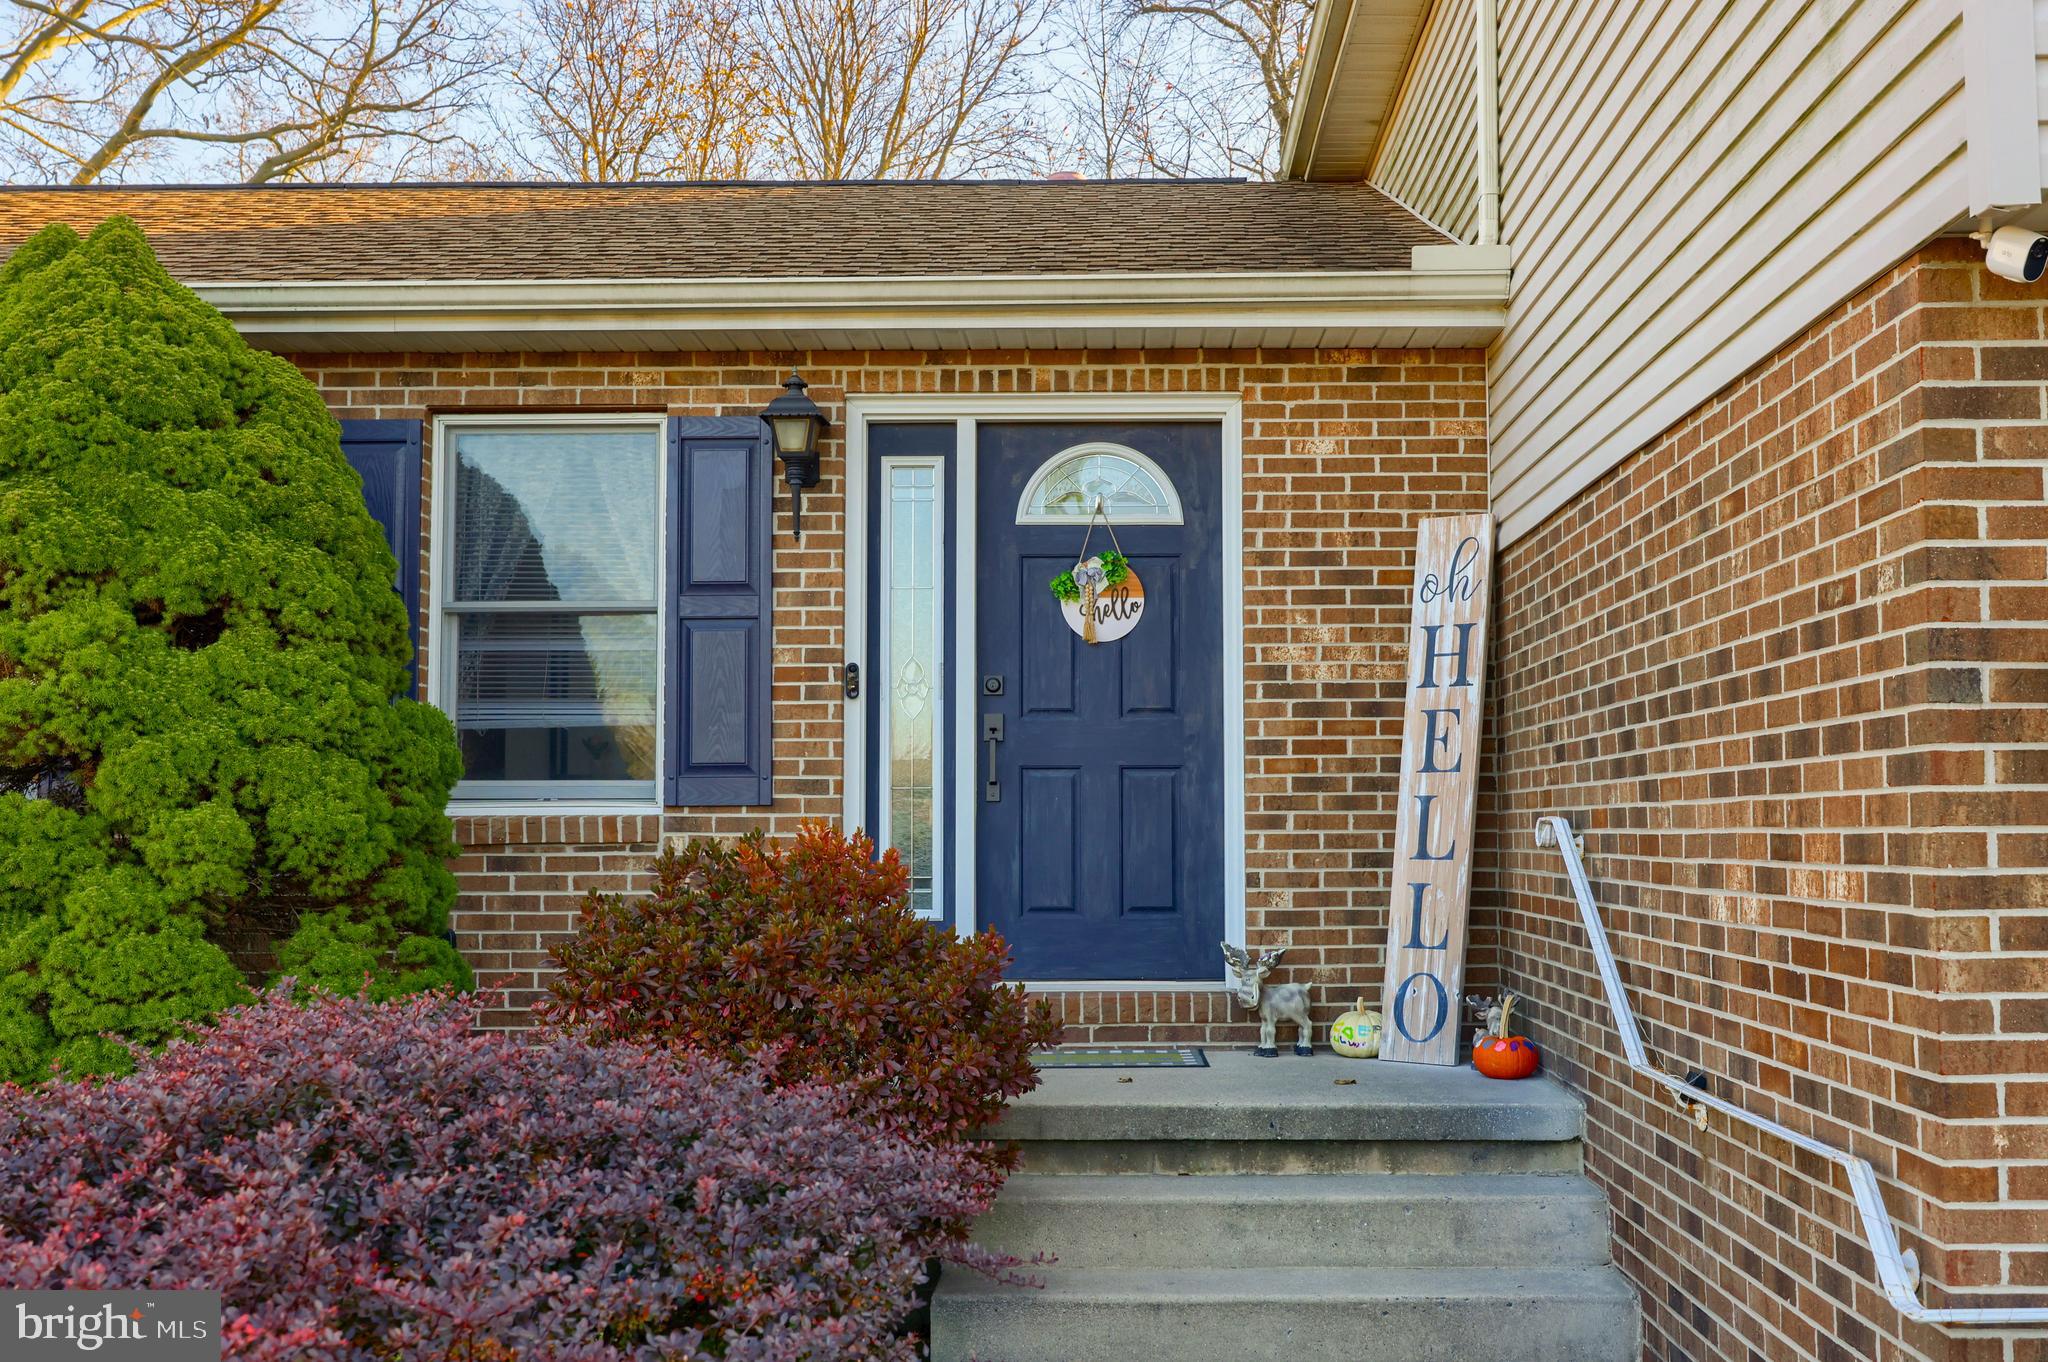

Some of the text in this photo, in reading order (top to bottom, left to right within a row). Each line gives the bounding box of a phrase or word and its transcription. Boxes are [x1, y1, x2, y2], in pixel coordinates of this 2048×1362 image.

[1420, 537, 1481, 603] oh
[1079, 586, 1141, 624] hello
[1394, 623, 1475, 1043] HELLO
